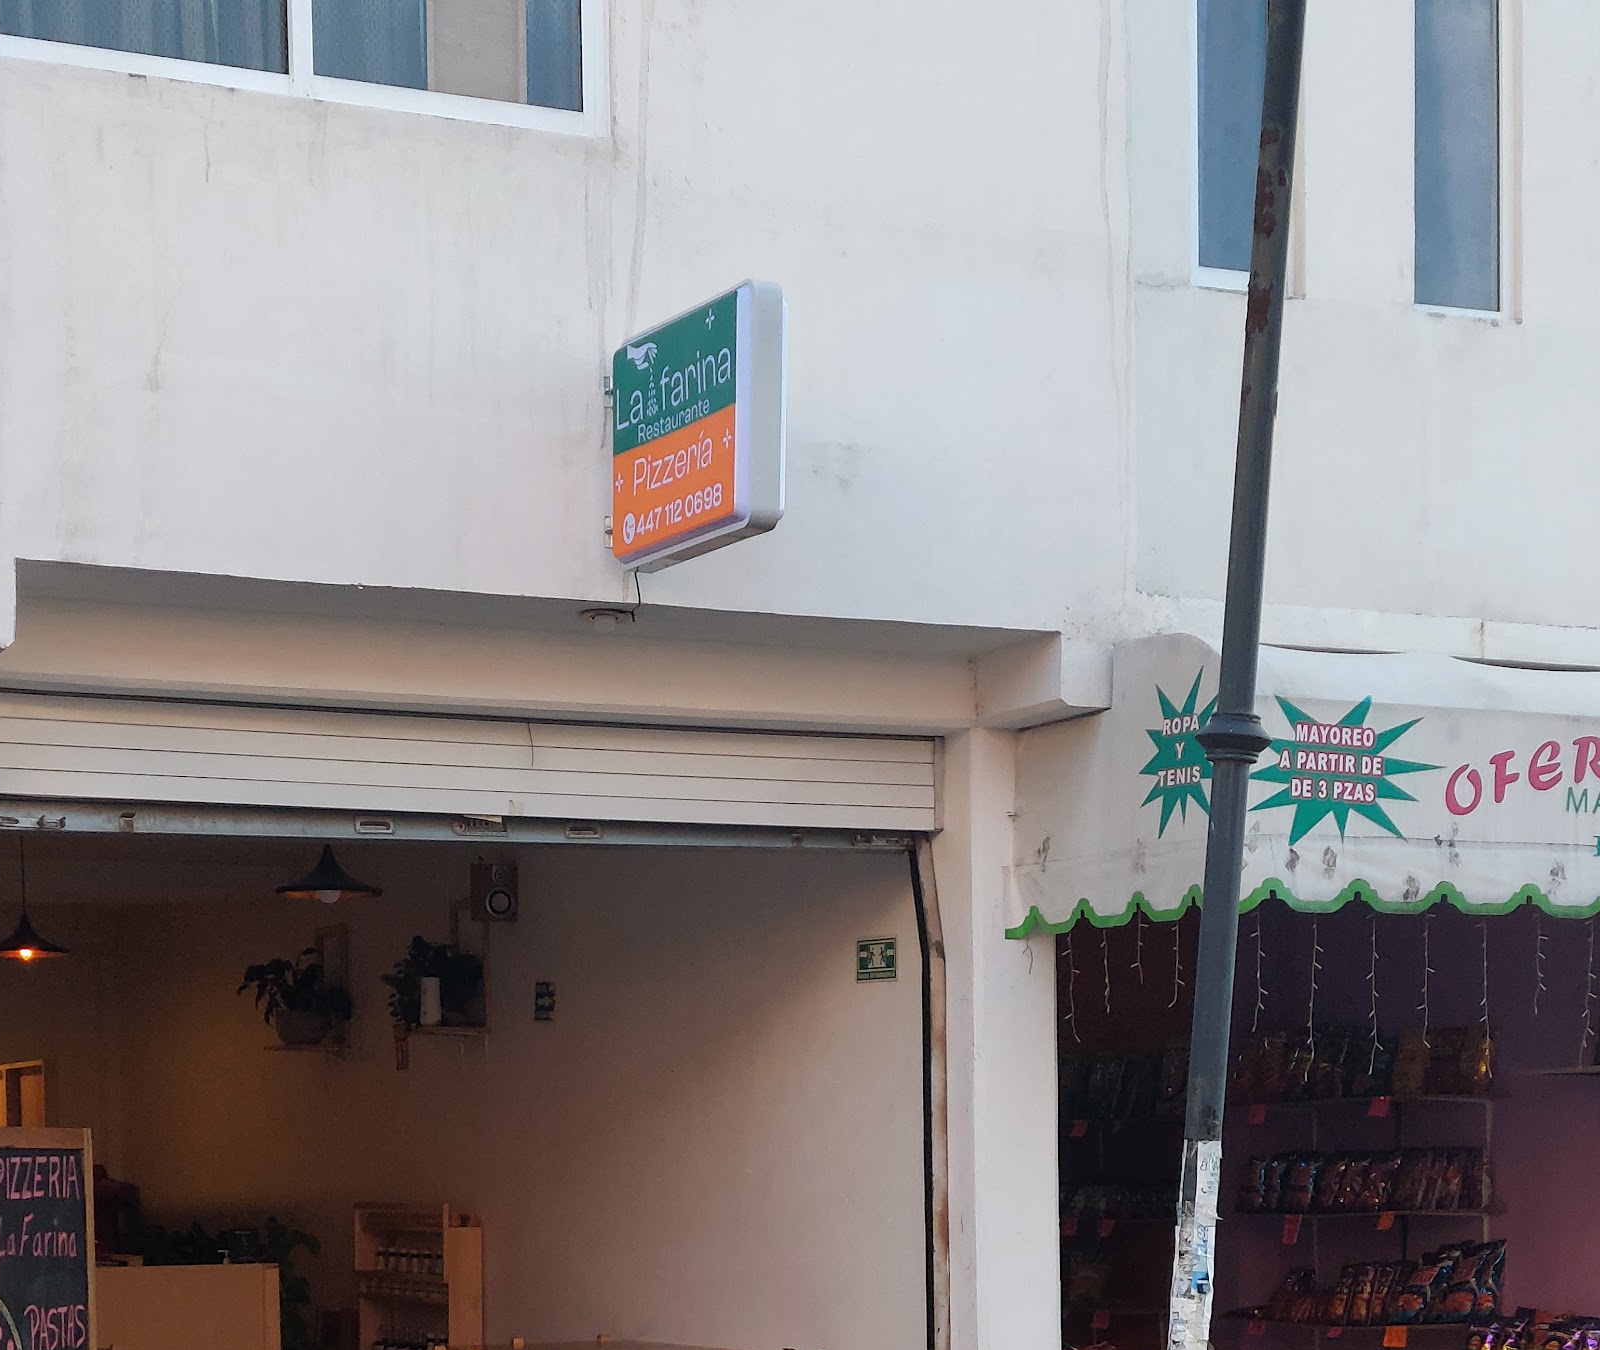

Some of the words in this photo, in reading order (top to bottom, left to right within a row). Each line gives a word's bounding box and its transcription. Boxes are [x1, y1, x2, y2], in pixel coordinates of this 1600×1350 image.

[616, 388, 643, 431] La
[660, 347, 732, 411] farina
[637, 399, 710, 444] Restaurante
[633, 431, 713, 496] Pizzería
[635, 506, 662, 536] 447
[665, 498, 683, 525] 112
[685, 482, 723, 518] 0698
[1296, 722, 1375, 748] MAYOREO
[1175, 741, 1184, 761] Y
[1279, 751, 1290, 769] A
[1296, 753, 1357, 775] PARTIR
[1361, 757, 1383, 777] DE
[1157, 765, 1201, 788] TENIS
[1291, 777, 1313, 799] DE
[1318, 780, 1328, 800] 3
[1332, 781, 1376, 803] PZAS
